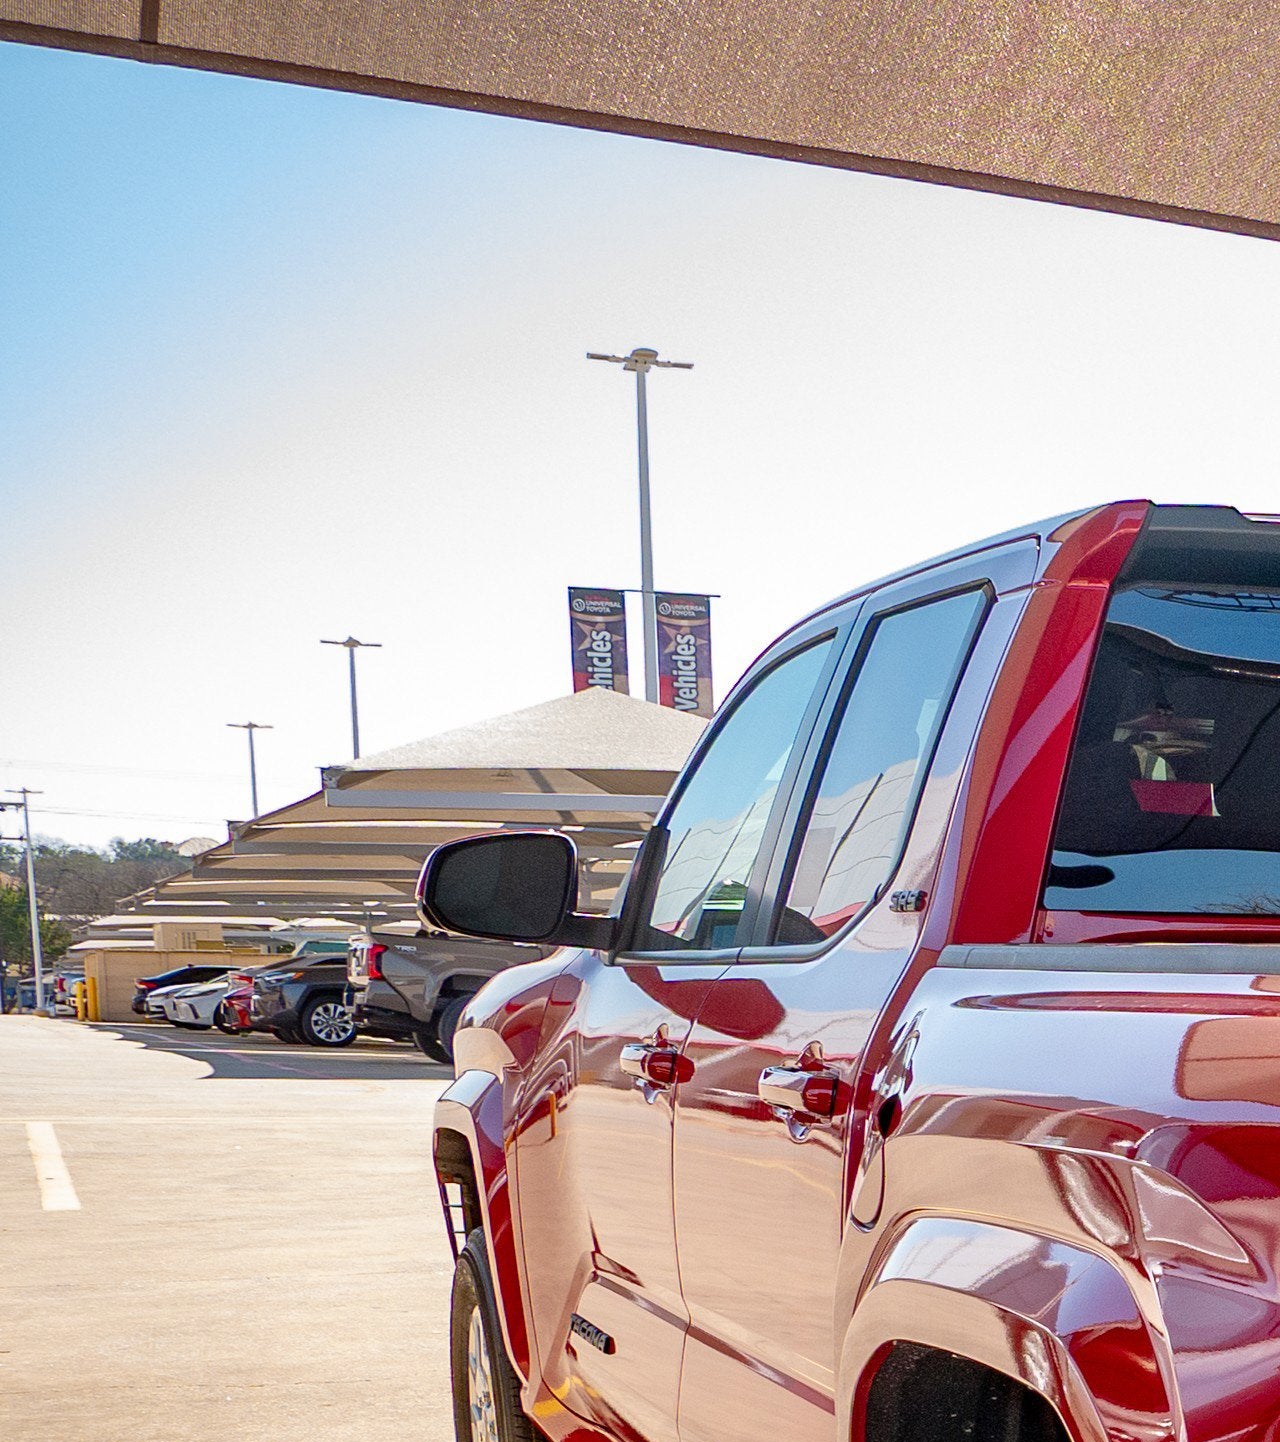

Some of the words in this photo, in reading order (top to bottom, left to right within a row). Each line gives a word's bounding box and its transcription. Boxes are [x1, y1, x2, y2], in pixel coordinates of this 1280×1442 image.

[585, 600, 622, 609] UNIVERSAL
[671, 604, 707, 612] UNIVERSAL
[587, 630, 613, 690] hicles
[671, 633, 698, 711] Vehicles
[889, 890, 919, 912] SR5
[571, 1313, 611, 1354] TACOMA
